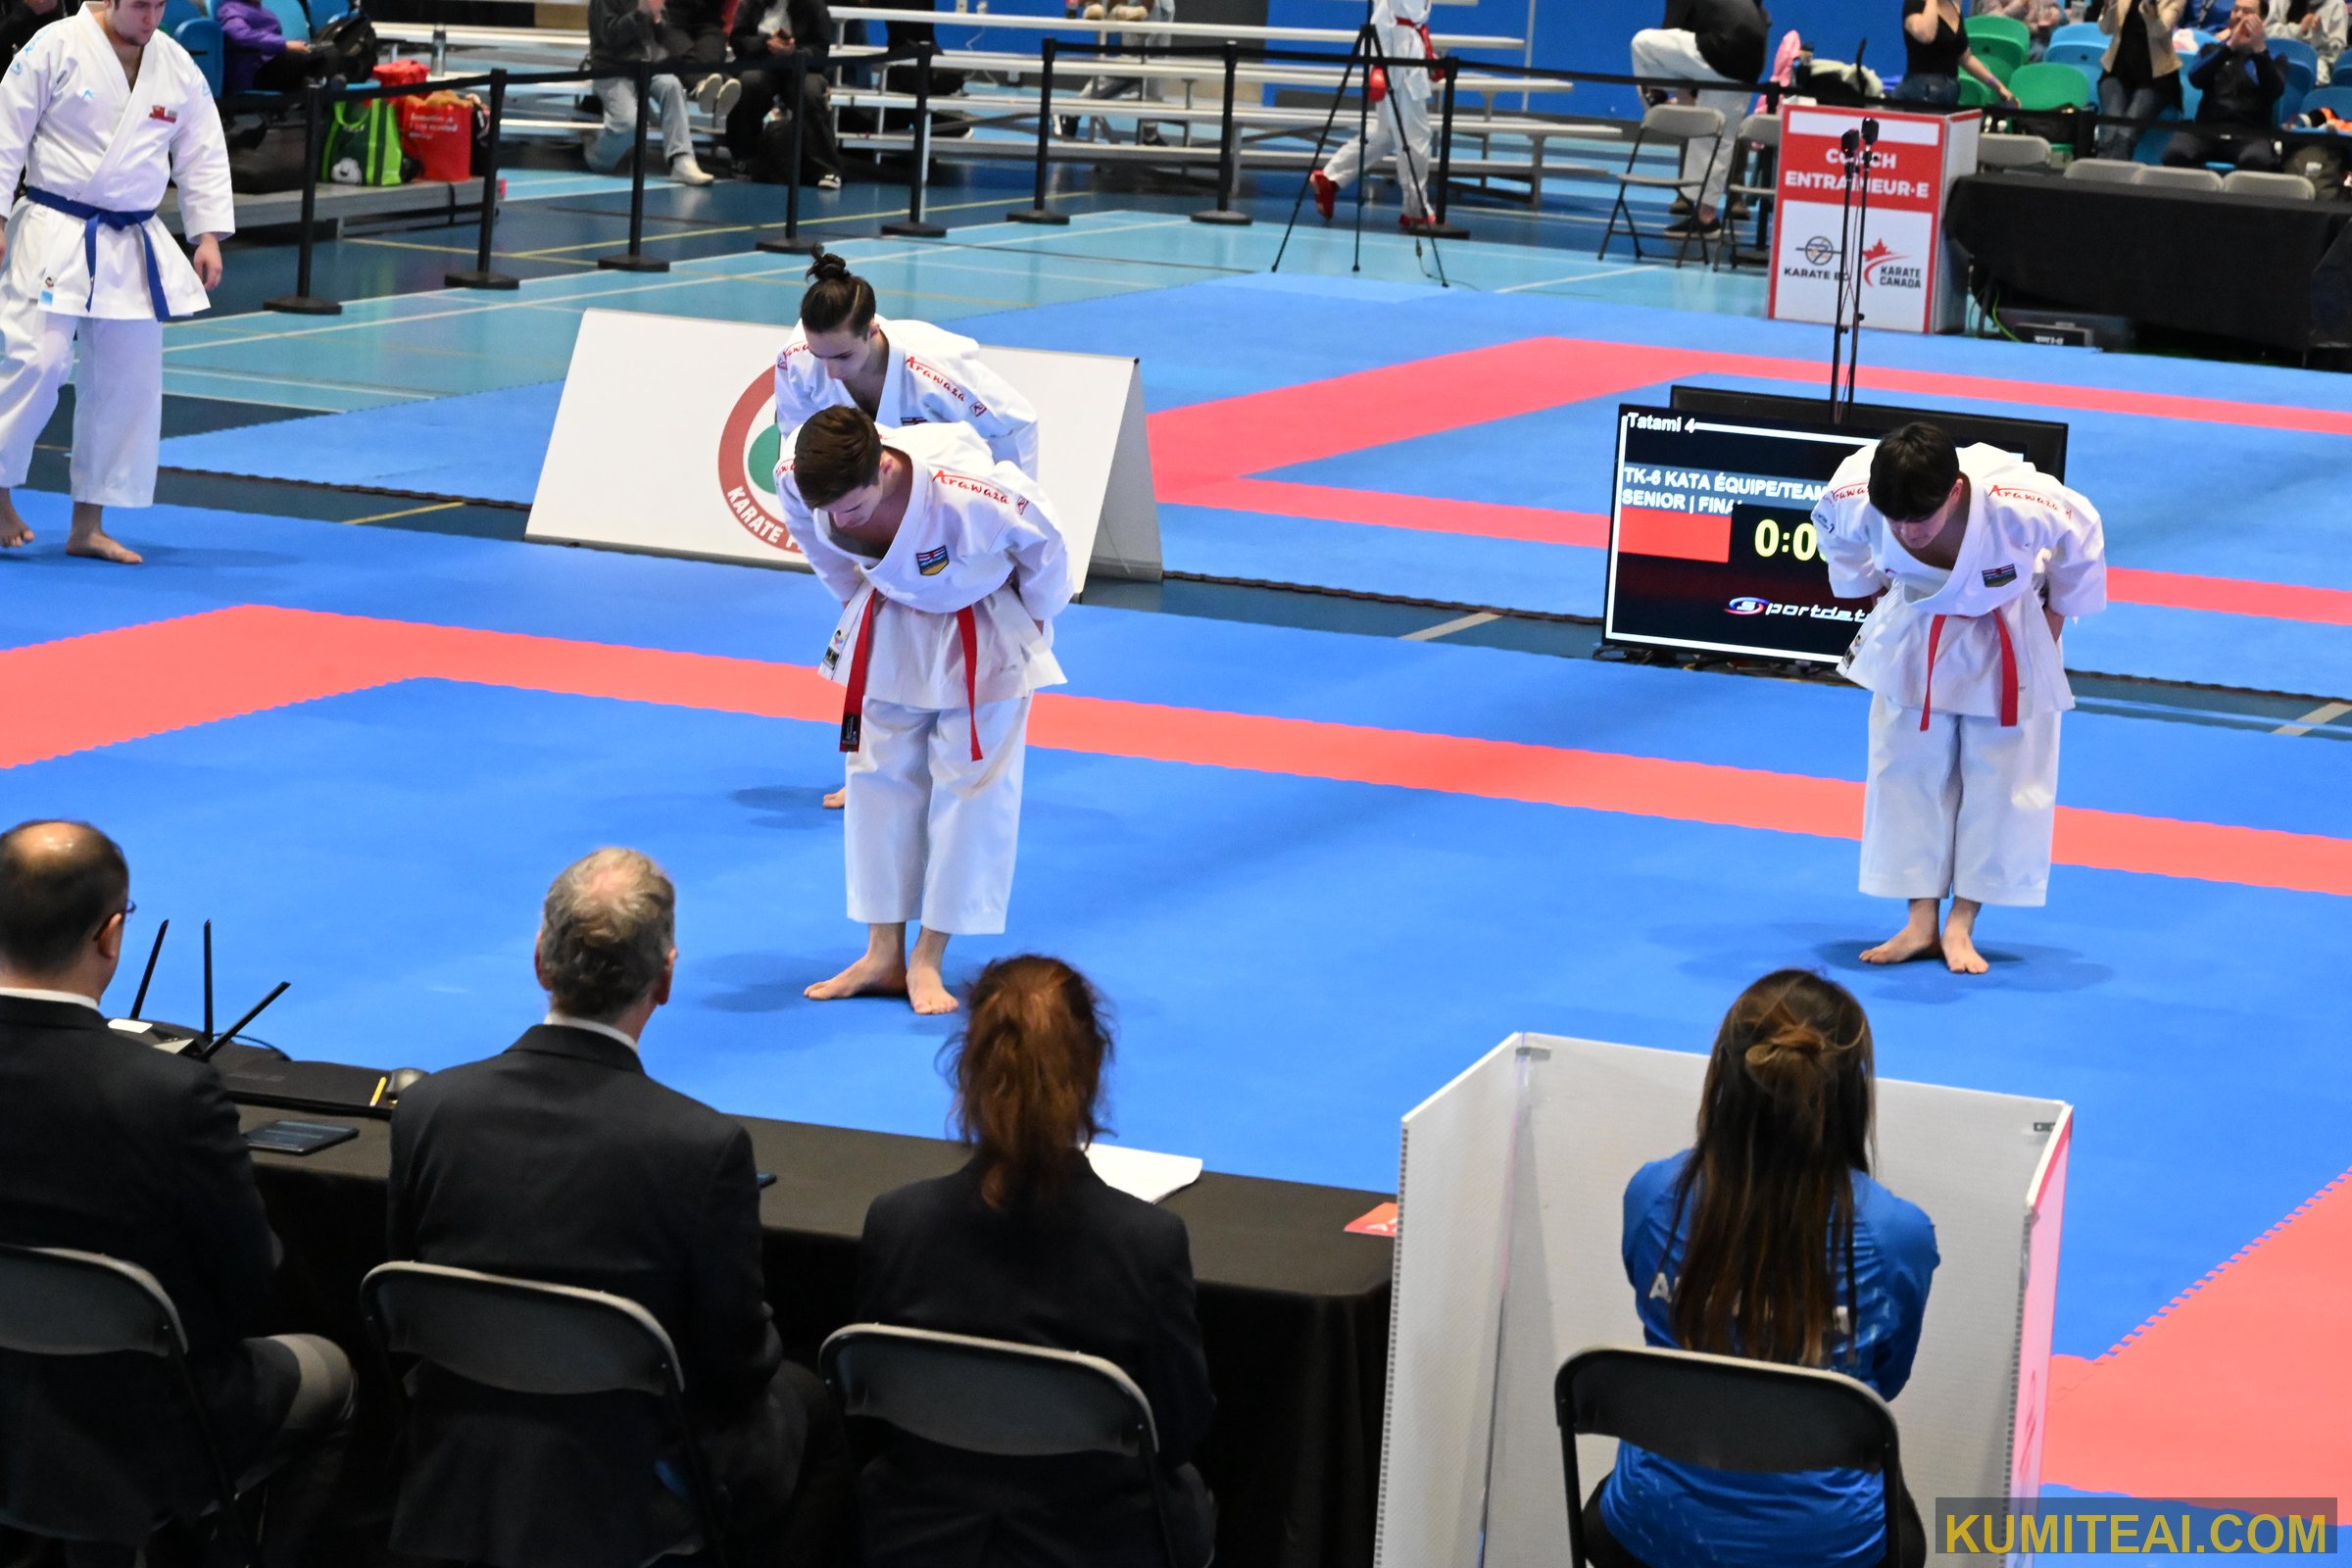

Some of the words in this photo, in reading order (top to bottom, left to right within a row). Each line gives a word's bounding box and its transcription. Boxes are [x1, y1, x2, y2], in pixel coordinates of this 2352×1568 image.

[1826, 148, 1896, 169] COCH
[1784, 267, 1830, 280] KARATE
[1880, 276, 1921, 288] CANADA
[1881, 266, 1921, 277] KARATE
[905, 356, 965, 402] Arawaza
[1627, 412, 1682, 432] Tatami
[1685, 417, 1694, 433] 4
[932, 469, 1010, 505] Arawaza
[1624, 466, 1661, 486] TK-6
[1665, 470, 1710, 490] KATA
[1622, 488, 1686, 510] SENIOR
[727, 486, 784, 544] KARATE
[1755, 518, 1826, 561] 0:0
